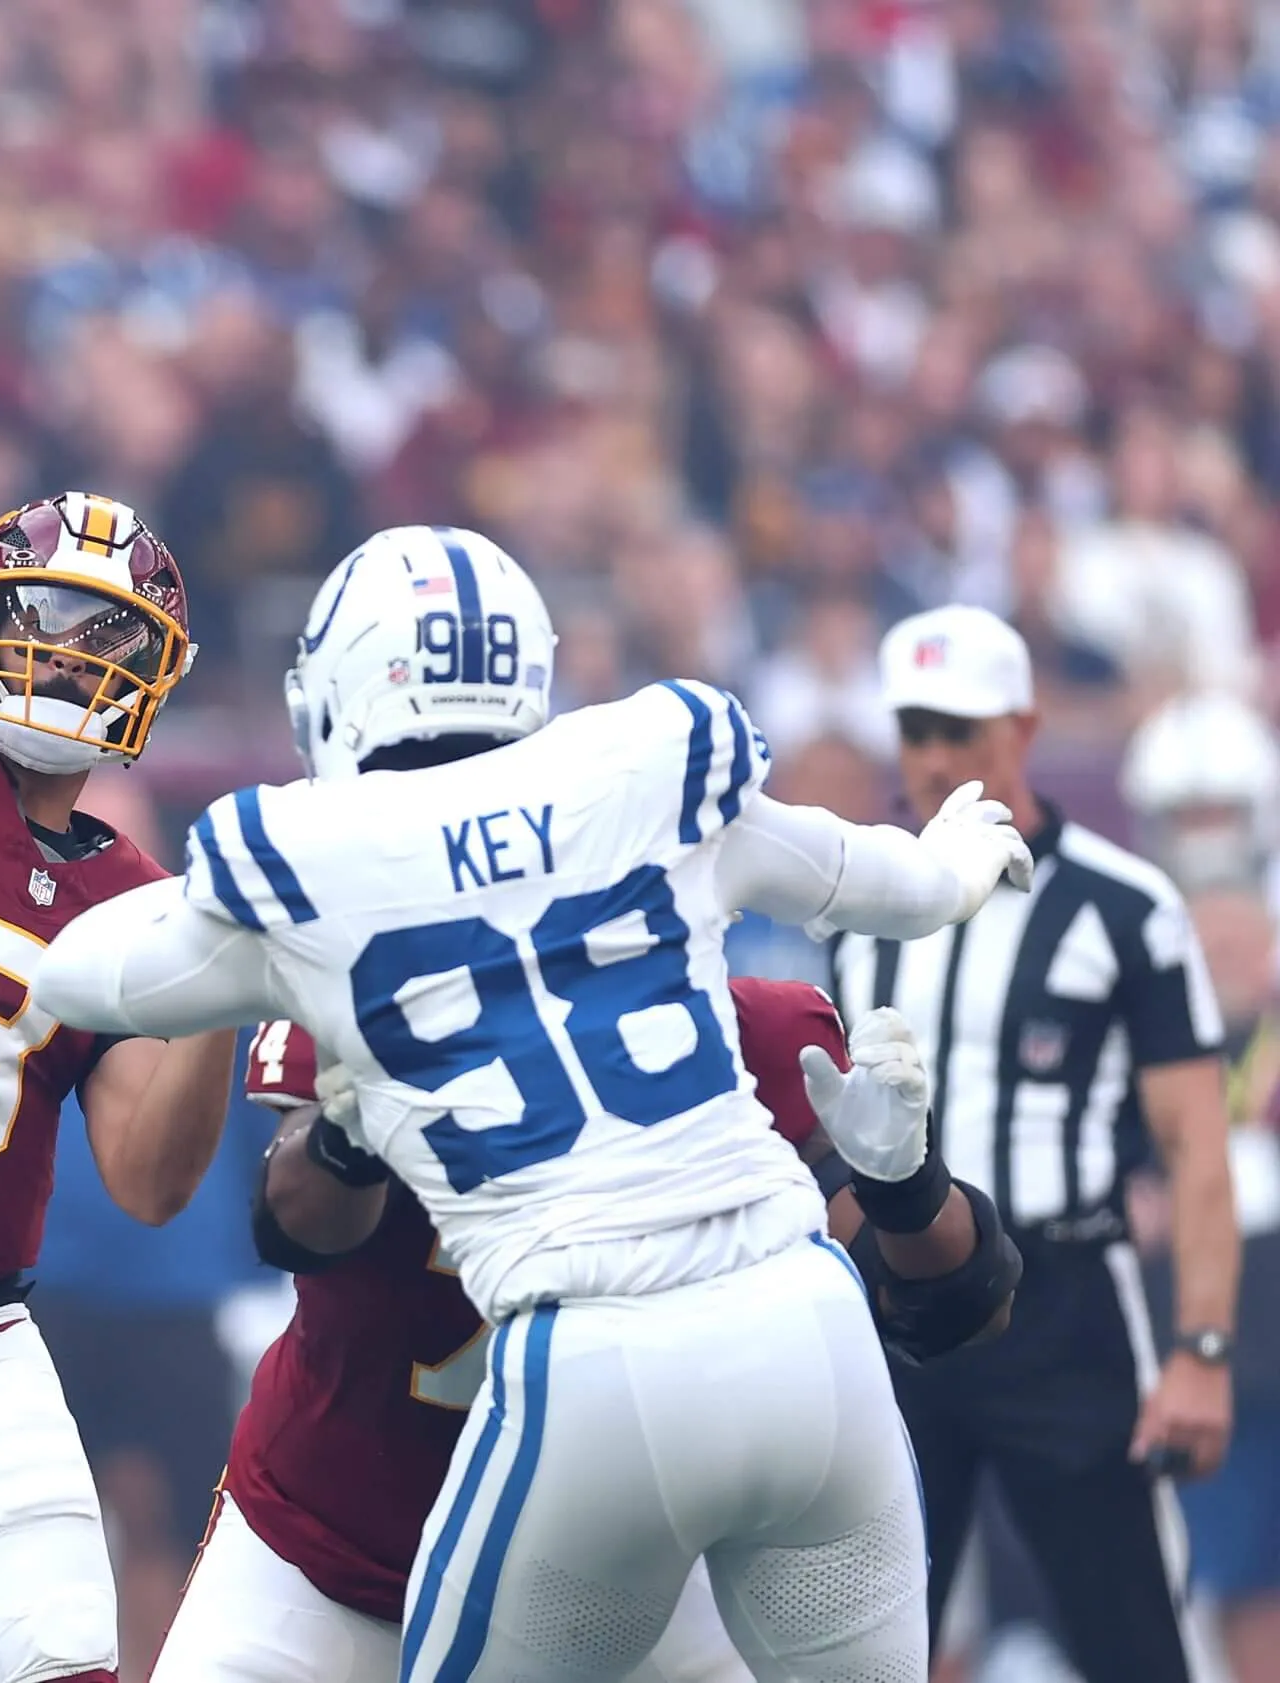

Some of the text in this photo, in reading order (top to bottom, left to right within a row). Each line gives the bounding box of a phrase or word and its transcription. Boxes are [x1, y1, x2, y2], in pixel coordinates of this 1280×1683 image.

[422, 611, 519, 686] 98
[441, 804, 555, 893] KEY
[349, 862, 740, 1196] 98
